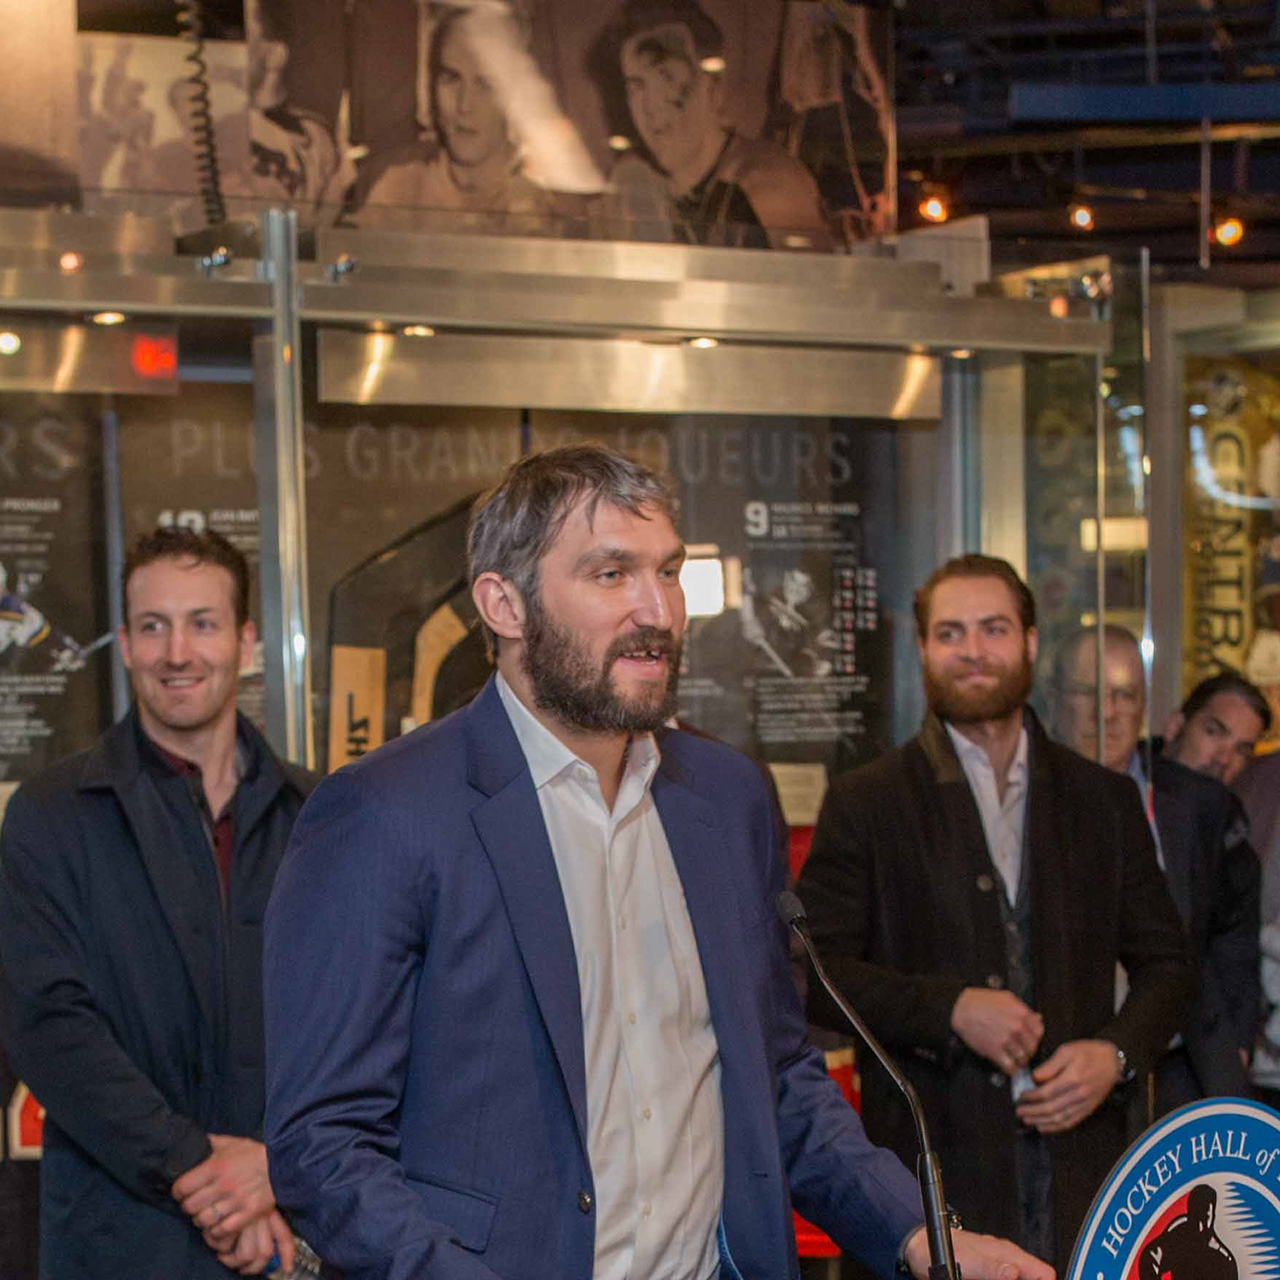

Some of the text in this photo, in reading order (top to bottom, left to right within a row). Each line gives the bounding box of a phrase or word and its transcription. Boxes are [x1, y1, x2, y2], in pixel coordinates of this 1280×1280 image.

[620, 429, 854, 485] OUEURS
[745, 501, 768, 537] 9
[1102, 1144, 1184, 1260] HOCKEY
[1190, 1129, 1252, 1165] HALL
[1256, 1147, 1280, 1177] of
